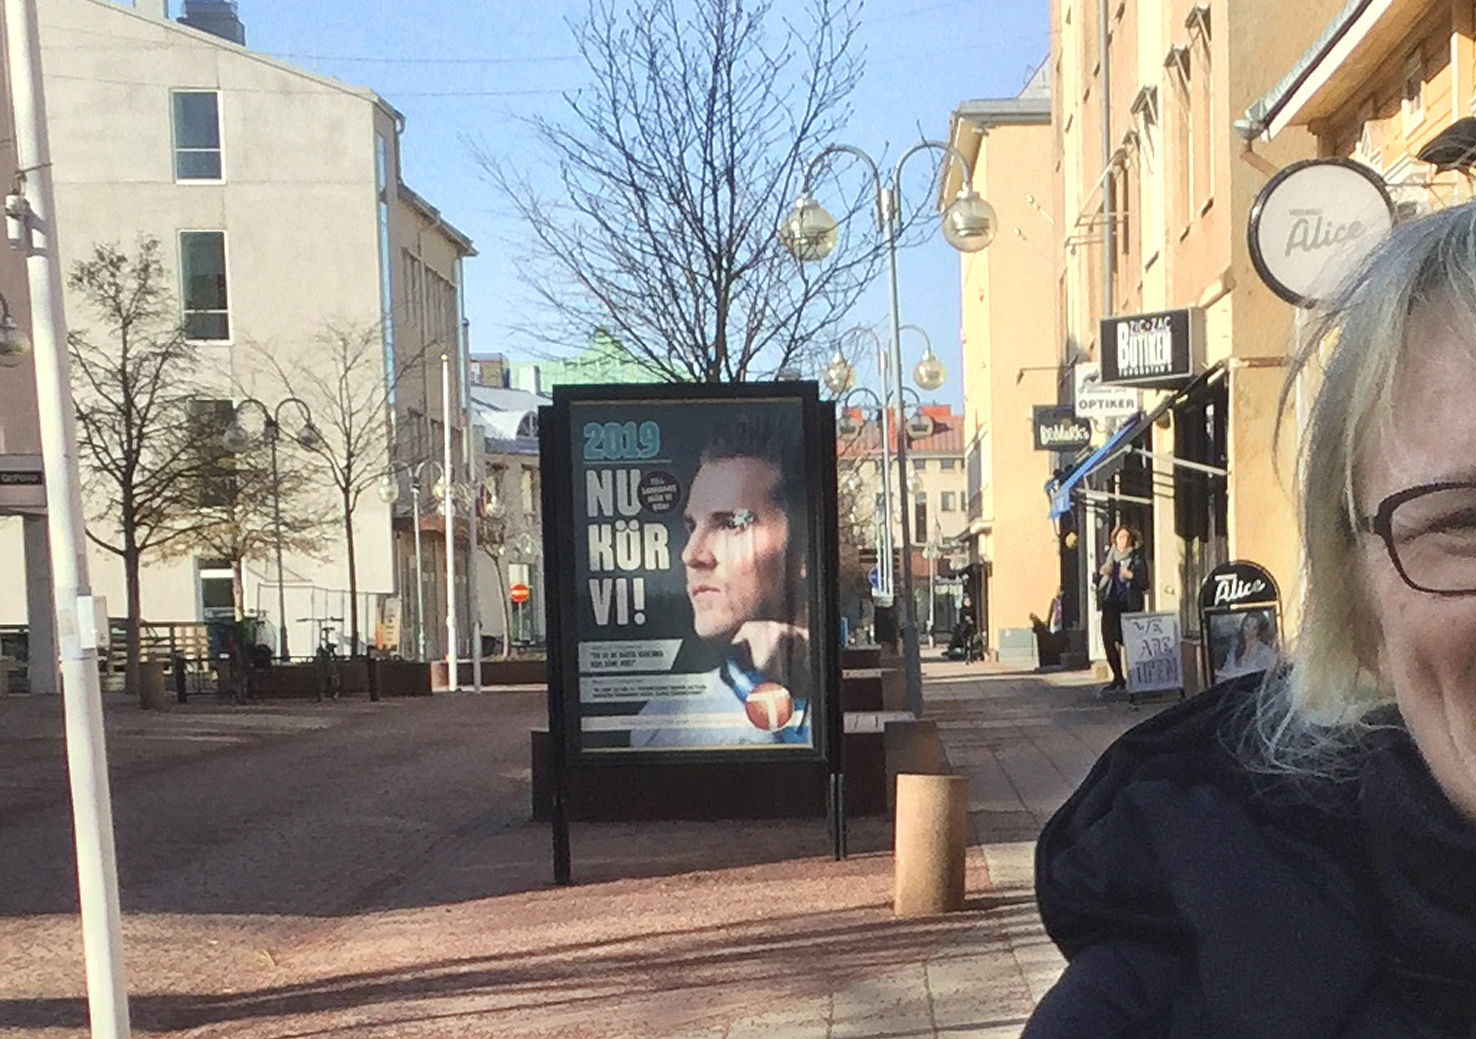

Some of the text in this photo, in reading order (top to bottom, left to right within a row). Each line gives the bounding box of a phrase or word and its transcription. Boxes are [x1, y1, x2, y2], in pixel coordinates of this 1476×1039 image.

[1284, 215, 1367, 257] Alice
[1078, 398, 1135, 410] OPTIKER
[583, 421, 660, 460] 2019
[586, 468, 642, 517] NU
[588, 519, 670, 571] KÖR
[588, 577, 646, 625] VI!
[1214, 575, 1266, 607] Alice
[1141, 636, 1173, 657] ARE
[1135, 656, 1179, 684] OPEN
